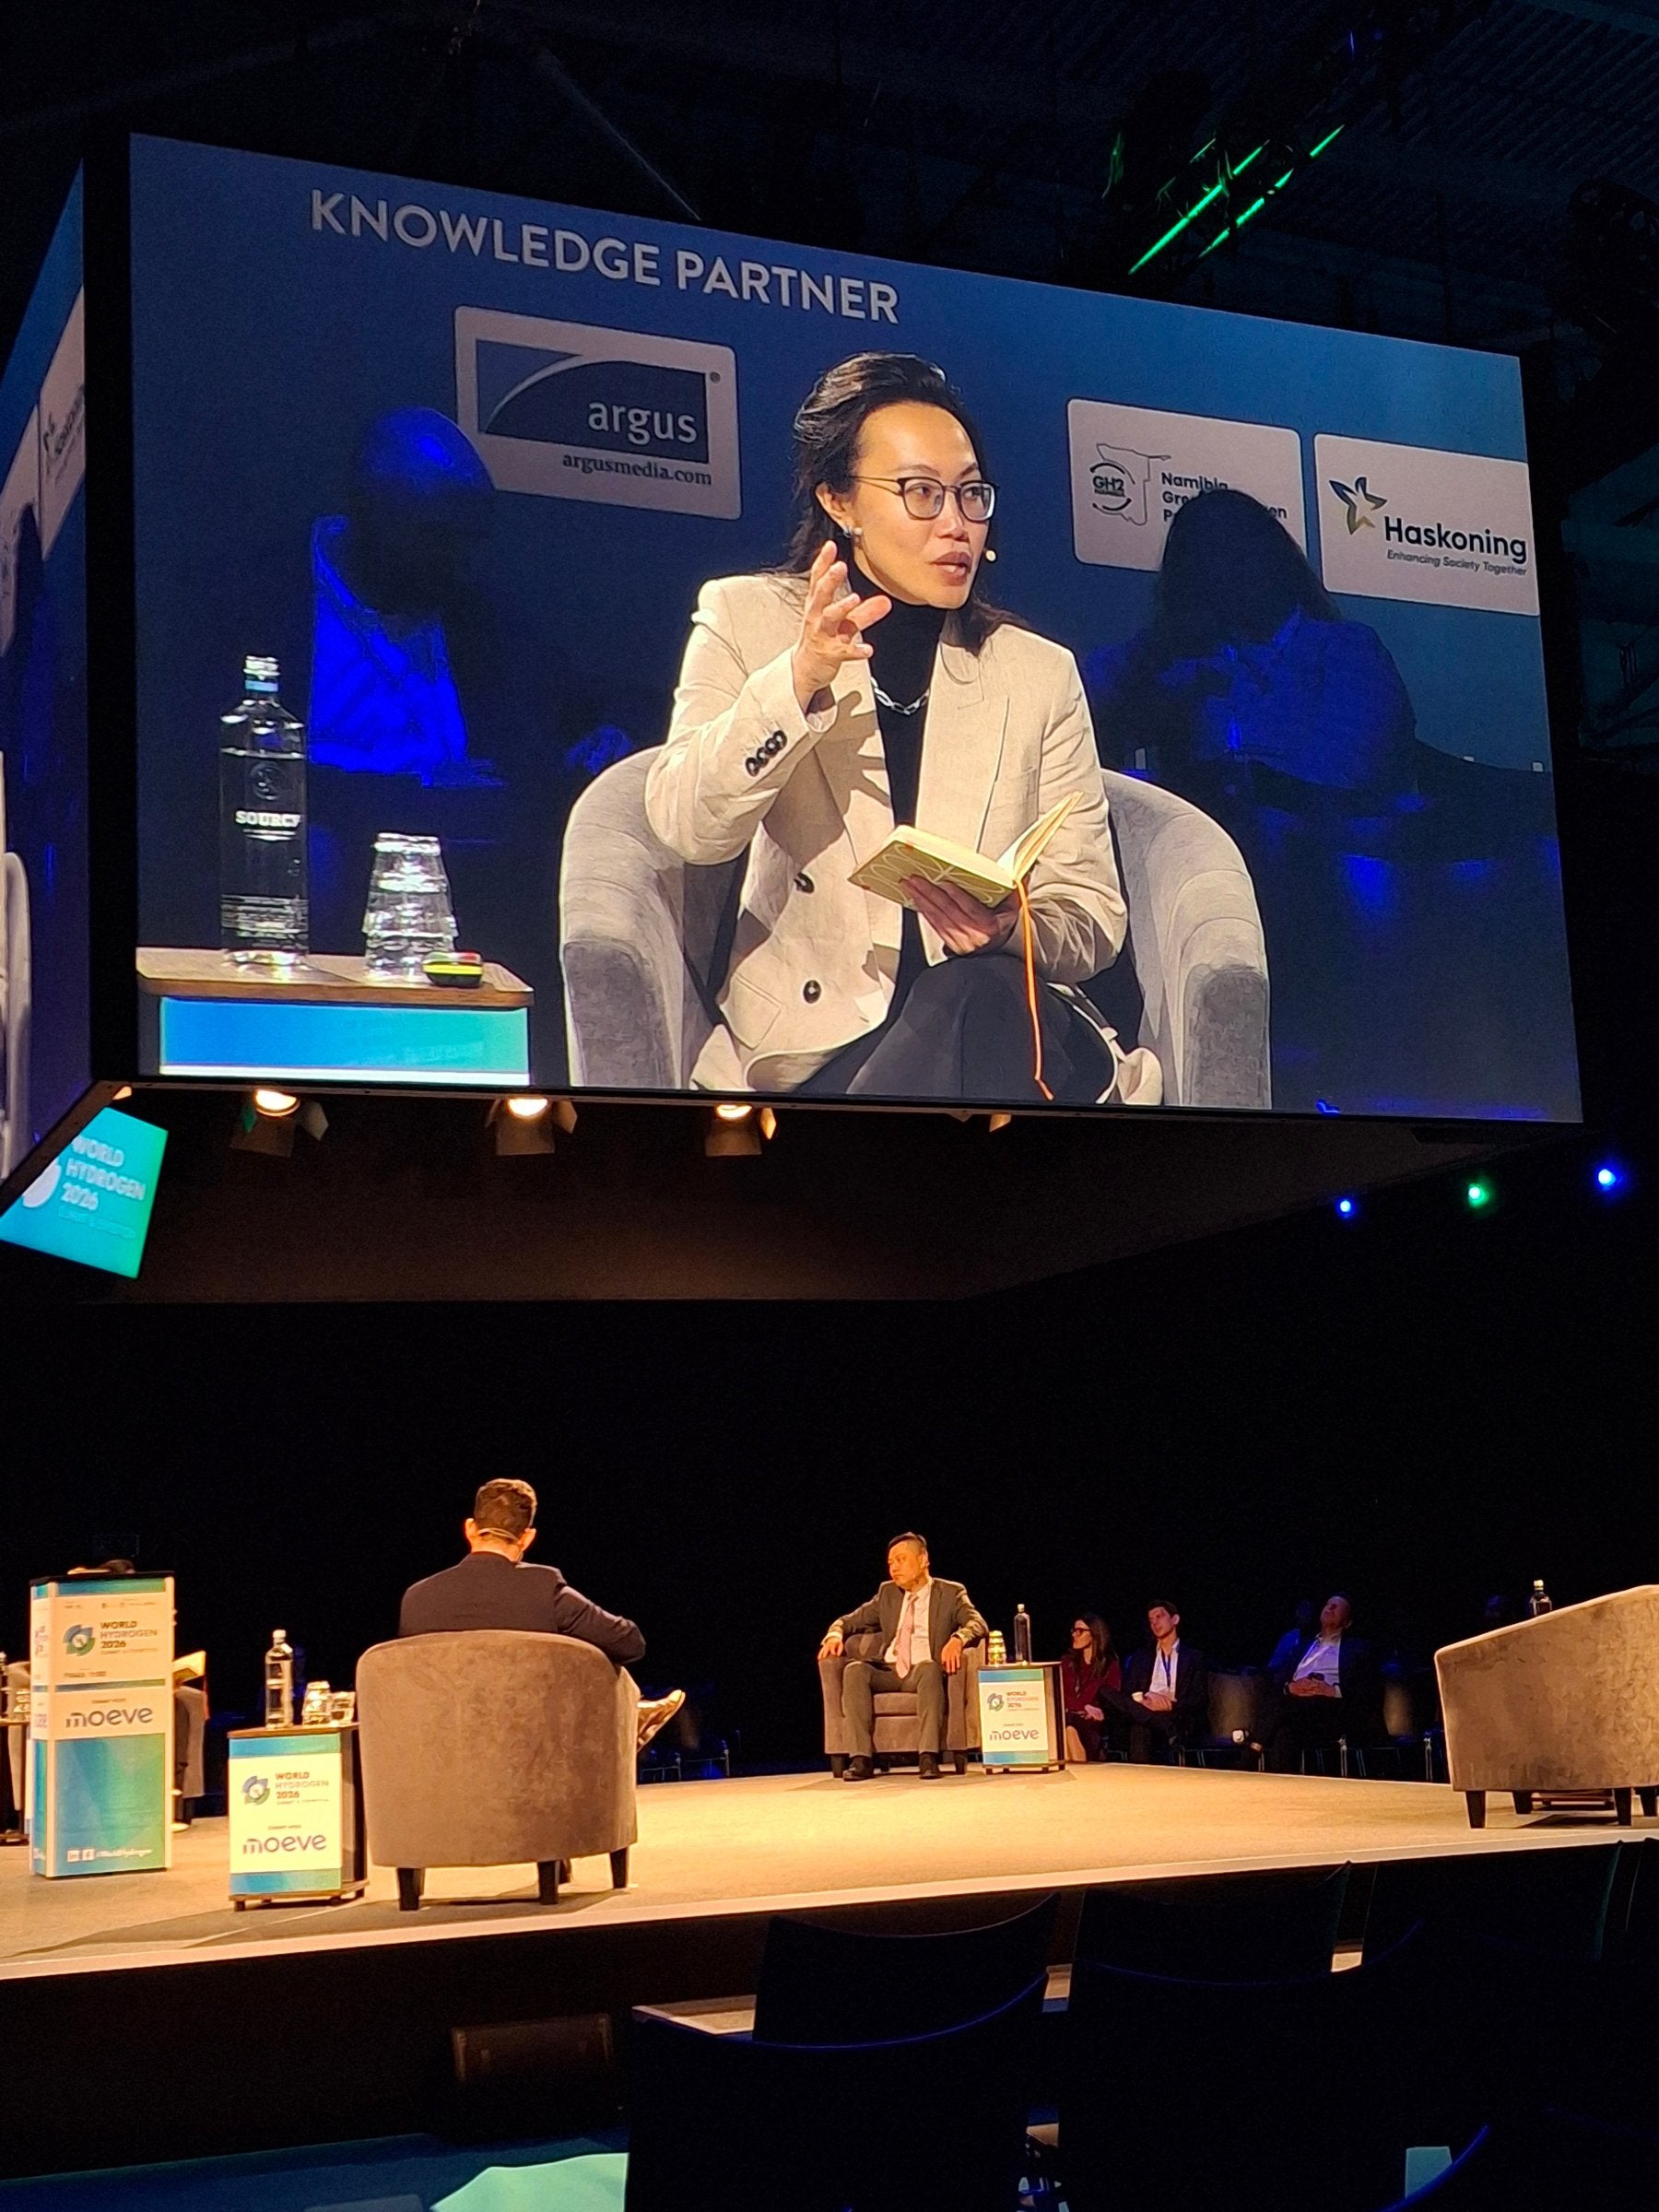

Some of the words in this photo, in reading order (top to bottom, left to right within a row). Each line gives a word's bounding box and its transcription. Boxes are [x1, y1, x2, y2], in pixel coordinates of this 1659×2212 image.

[310, 189, 661, 286] KNOWLEDGE
[677, 249, 900, 324] PARTNER
[588, 399, 698, 445] argus
[562, 453, 712, 486] argusmedia.com
[1092, 476, 1124, 491] GH2
[1384, 516, 1527, 564] Haskoning
[1387, 549, 1441, 567] Enhancing
[1443, 557, 1480, 571] Society
[1483, 561, 1527, 576] Together
[72, 1135, 124, 1168] WORLD
[100, 1621, 137, 1630] WORLD
[100, 1630, 158, 1639] HYDROGEN
[100, 1641, 126, 1649] 2026
[65, 1708, 154, 1728] moeve
[990, 1728, 1040, 1741] moeve
[276, 1771, 310, 1780] WORLD
[276, 1791, 300, 1799] 2026
[242, 1835, 327, 1854] moeve
